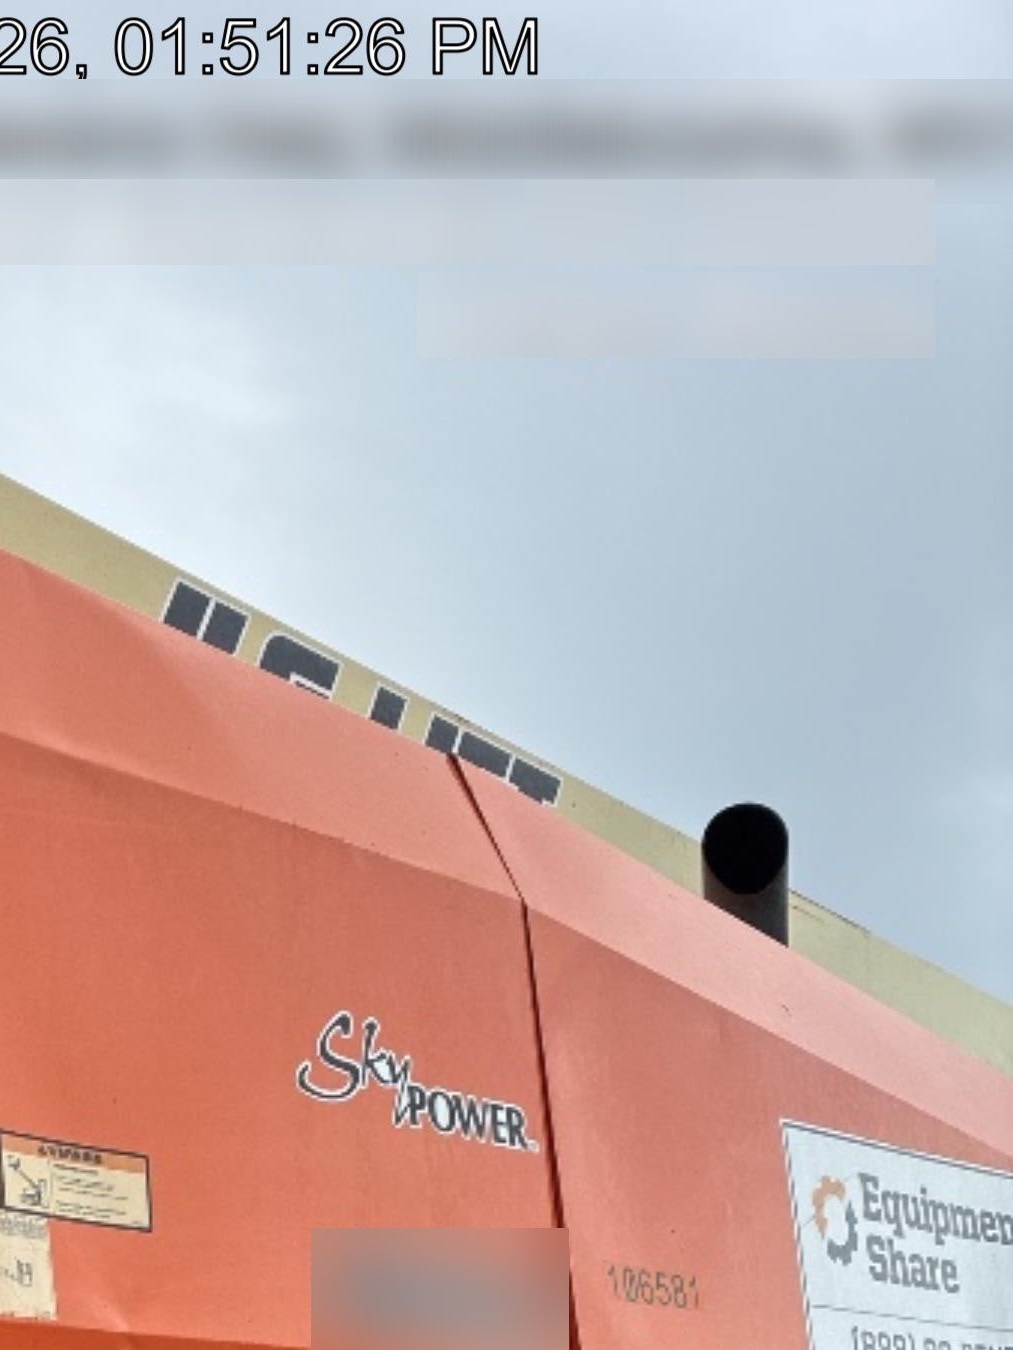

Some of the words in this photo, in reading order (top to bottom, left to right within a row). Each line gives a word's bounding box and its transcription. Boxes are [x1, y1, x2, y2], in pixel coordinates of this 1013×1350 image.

[297, 1011, 412, 1126] Sky
[405, 1084, 530, 1150] POWER
[865, 1233, 961, 1294] Share
